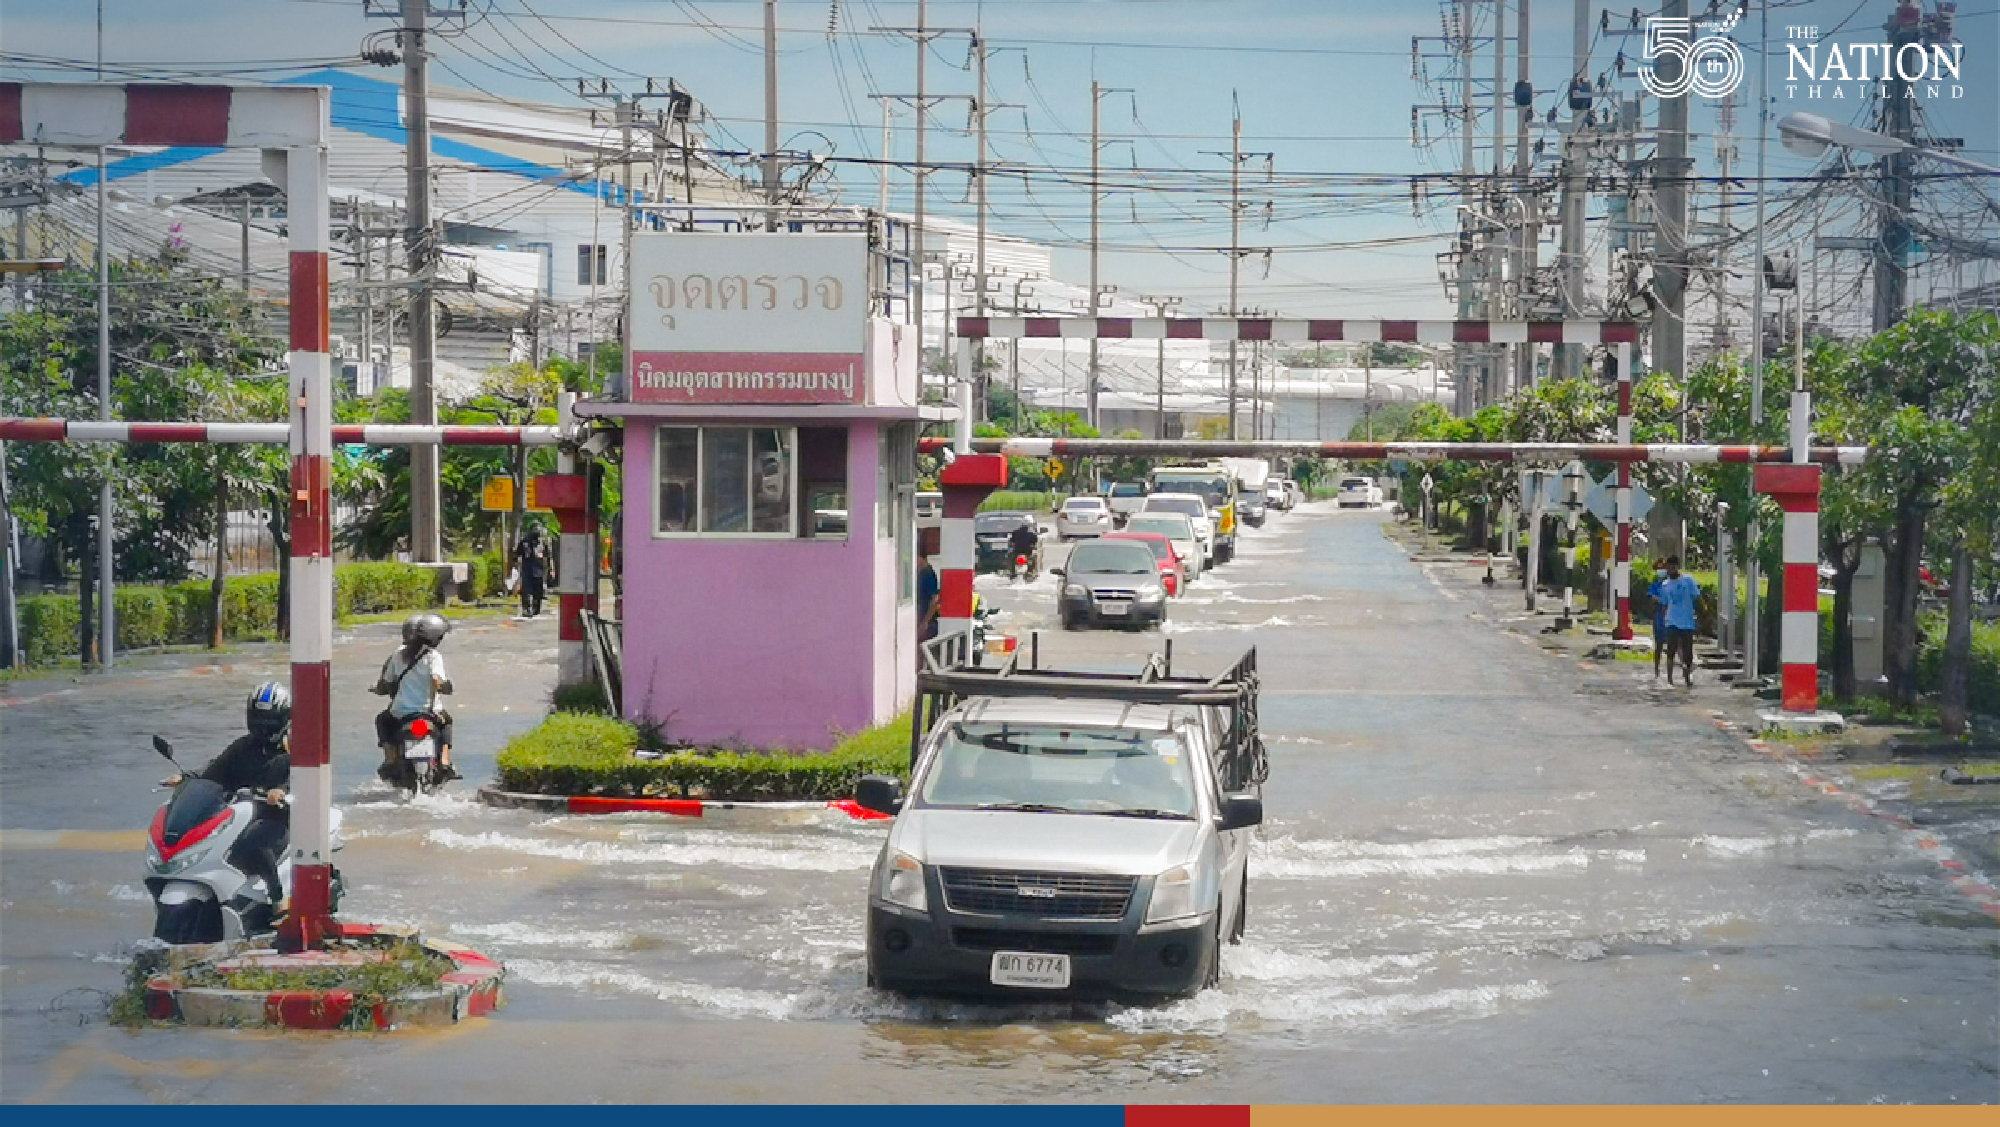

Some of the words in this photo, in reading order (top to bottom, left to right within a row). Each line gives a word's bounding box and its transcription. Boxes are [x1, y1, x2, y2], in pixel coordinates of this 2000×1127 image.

[648, 274, 843, 331] จุดตรวจ
[637, 361, 855, 398] นิคมอุตสาหกรรมบางปู
[1026, 957, 1063, 973] 6774
